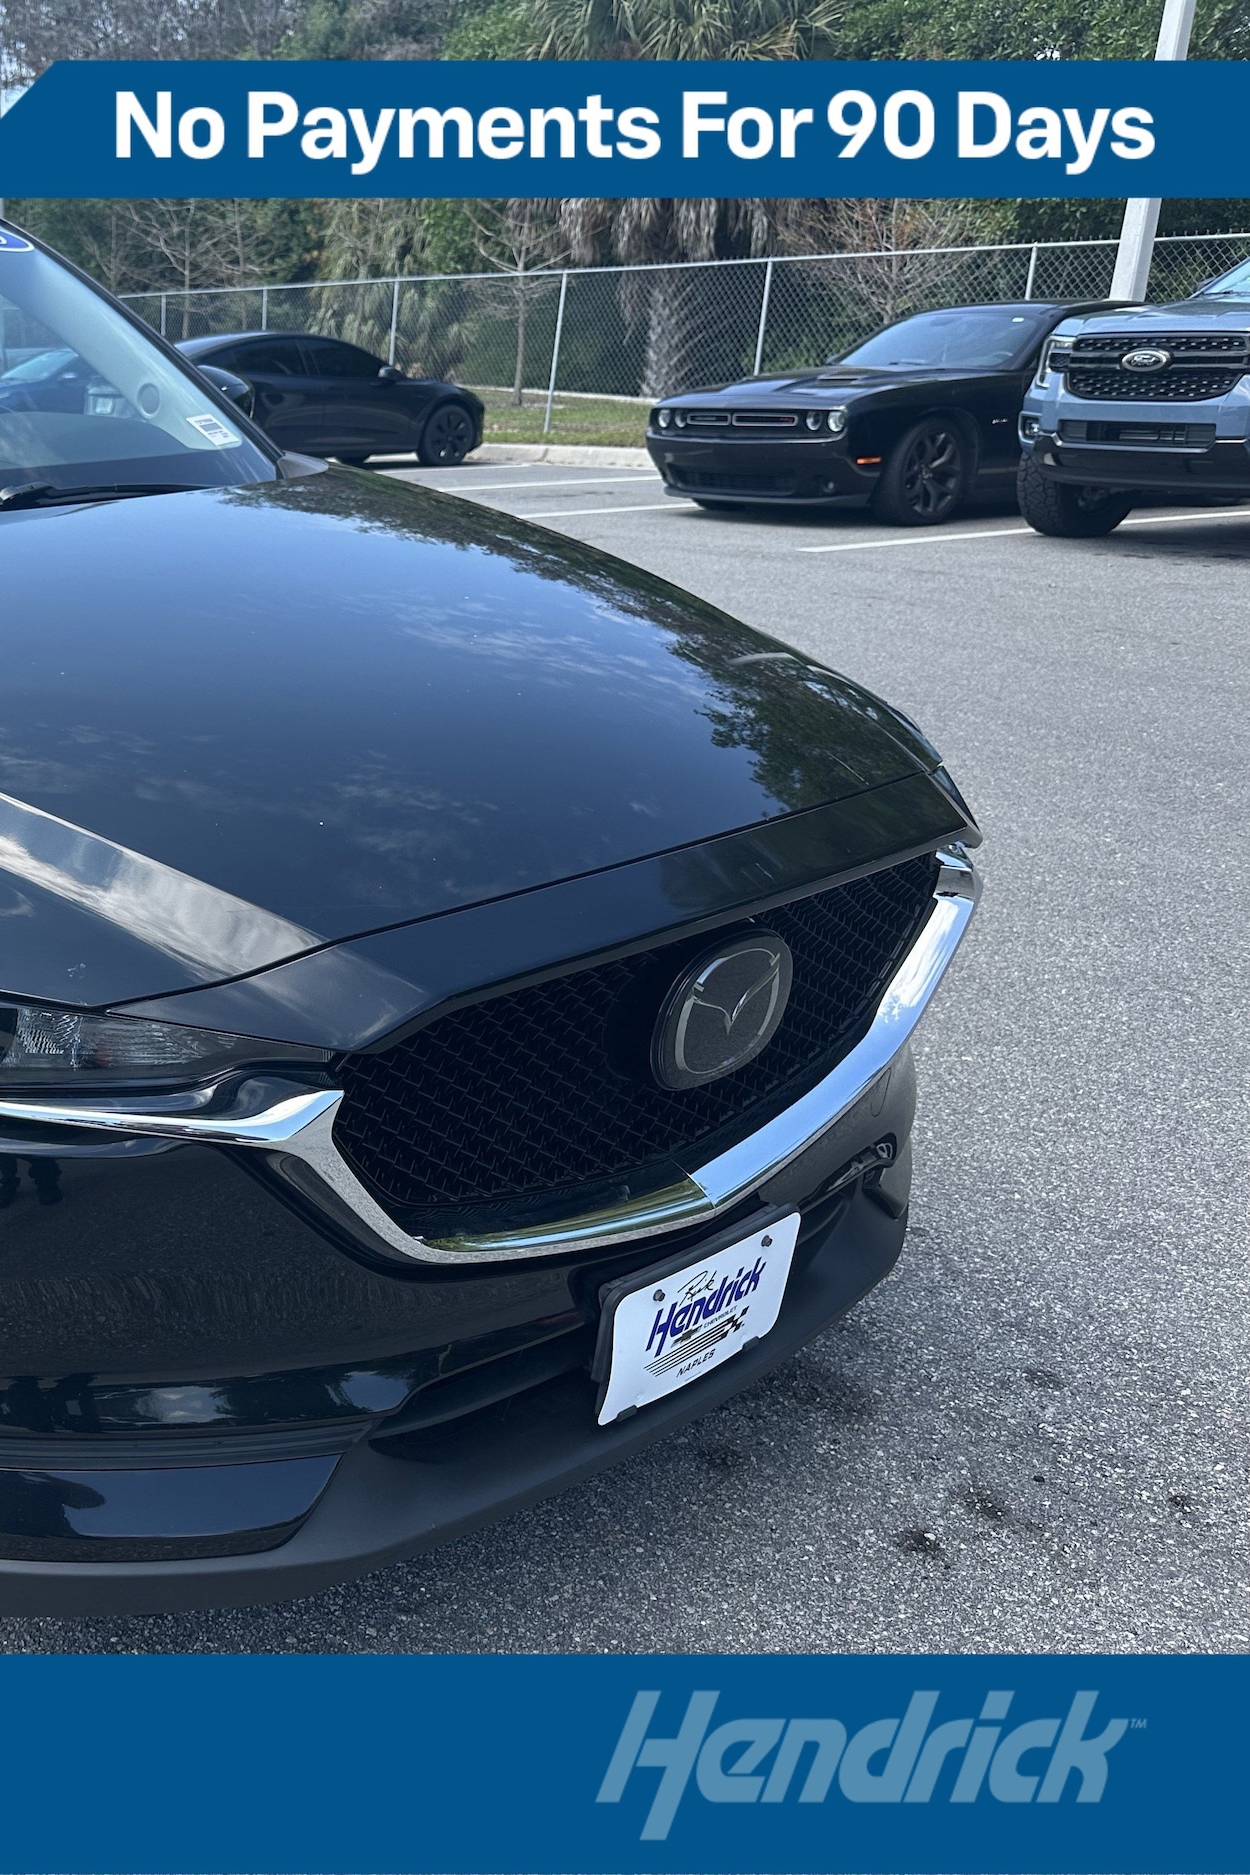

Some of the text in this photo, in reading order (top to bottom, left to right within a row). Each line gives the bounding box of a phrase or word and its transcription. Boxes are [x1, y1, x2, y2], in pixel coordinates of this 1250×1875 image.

[645, 1256, 767, 1358] Hendrick
[703, 1305, 738, 1329] CHEVROLET
[676, 1348, 716, 1378] NAPLES
